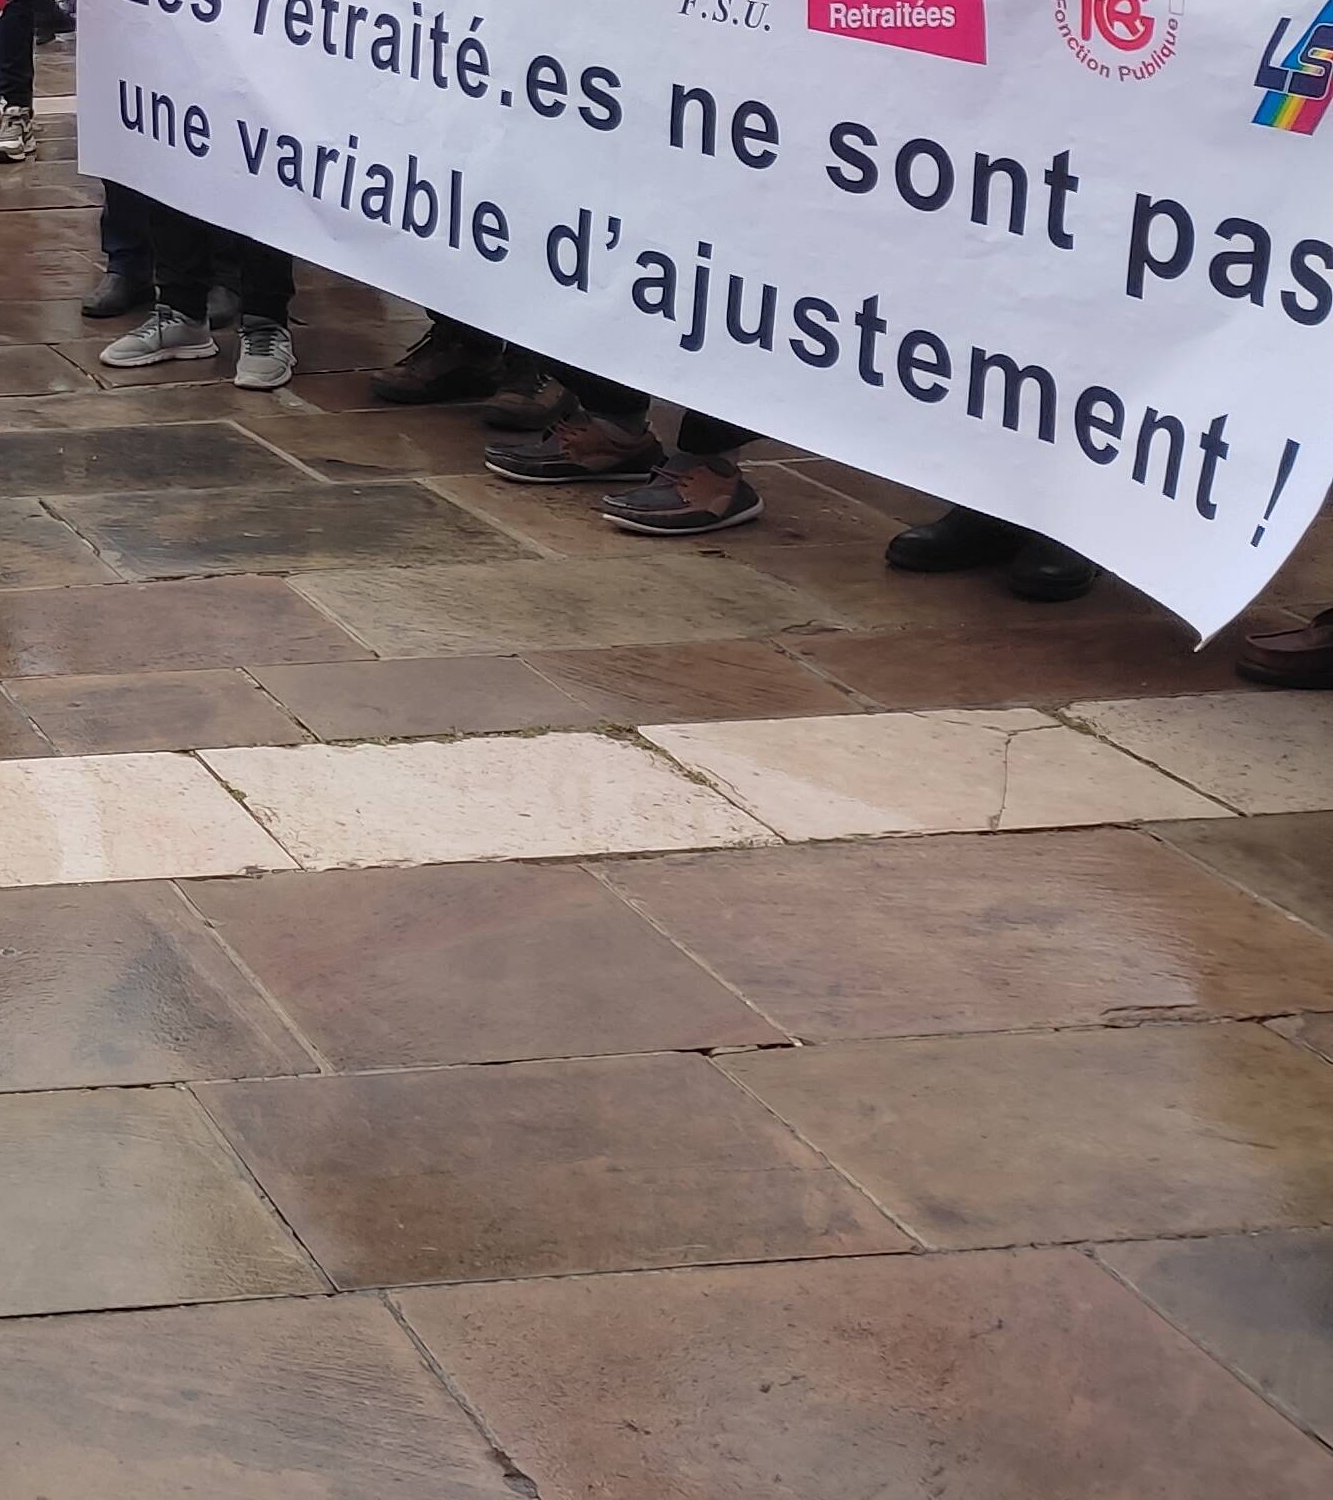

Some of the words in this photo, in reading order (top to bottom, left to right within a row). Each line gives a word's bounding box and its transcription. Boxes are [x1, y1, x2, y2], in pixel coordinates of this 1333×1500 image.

[828, 0, 957, 30] Retraitées
[1118, 17, 1179, 82] Publique
[668, 82, 781, 171] ne
[824, 119, 1081, 251] sont
[1125, 191, 1333, 327] pas
[117, 79, 212, 159] une
[235, 118, 511, 264] variable
[545, 206, 1232, 522] d'ajustement
